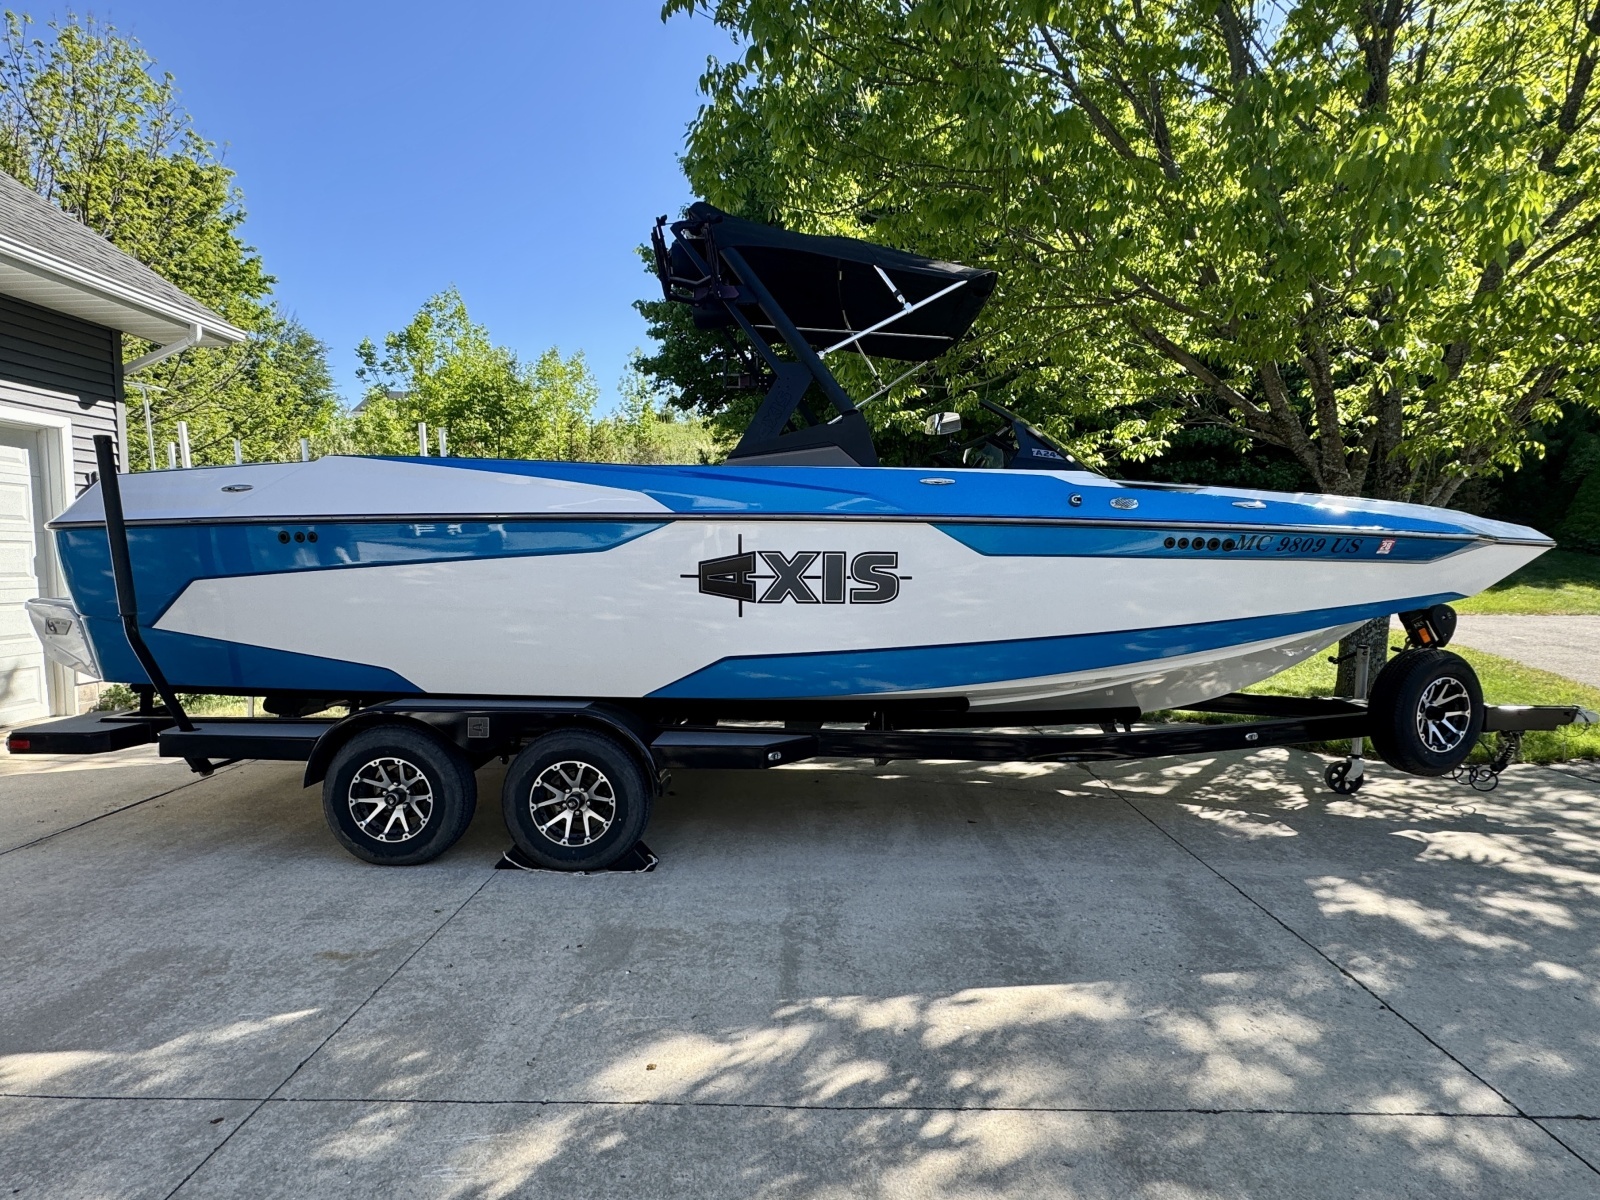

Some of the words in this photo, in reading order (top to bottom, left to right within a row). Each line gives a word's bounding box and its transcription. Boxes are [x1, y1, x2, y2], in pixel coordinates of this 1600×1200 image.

[1233, 534, 1274, 552] MC
[1275, 536, 1326, 553] 9809
[1331, 538, 1363, 554] US
[699, 550, 900, 605] AXIS
